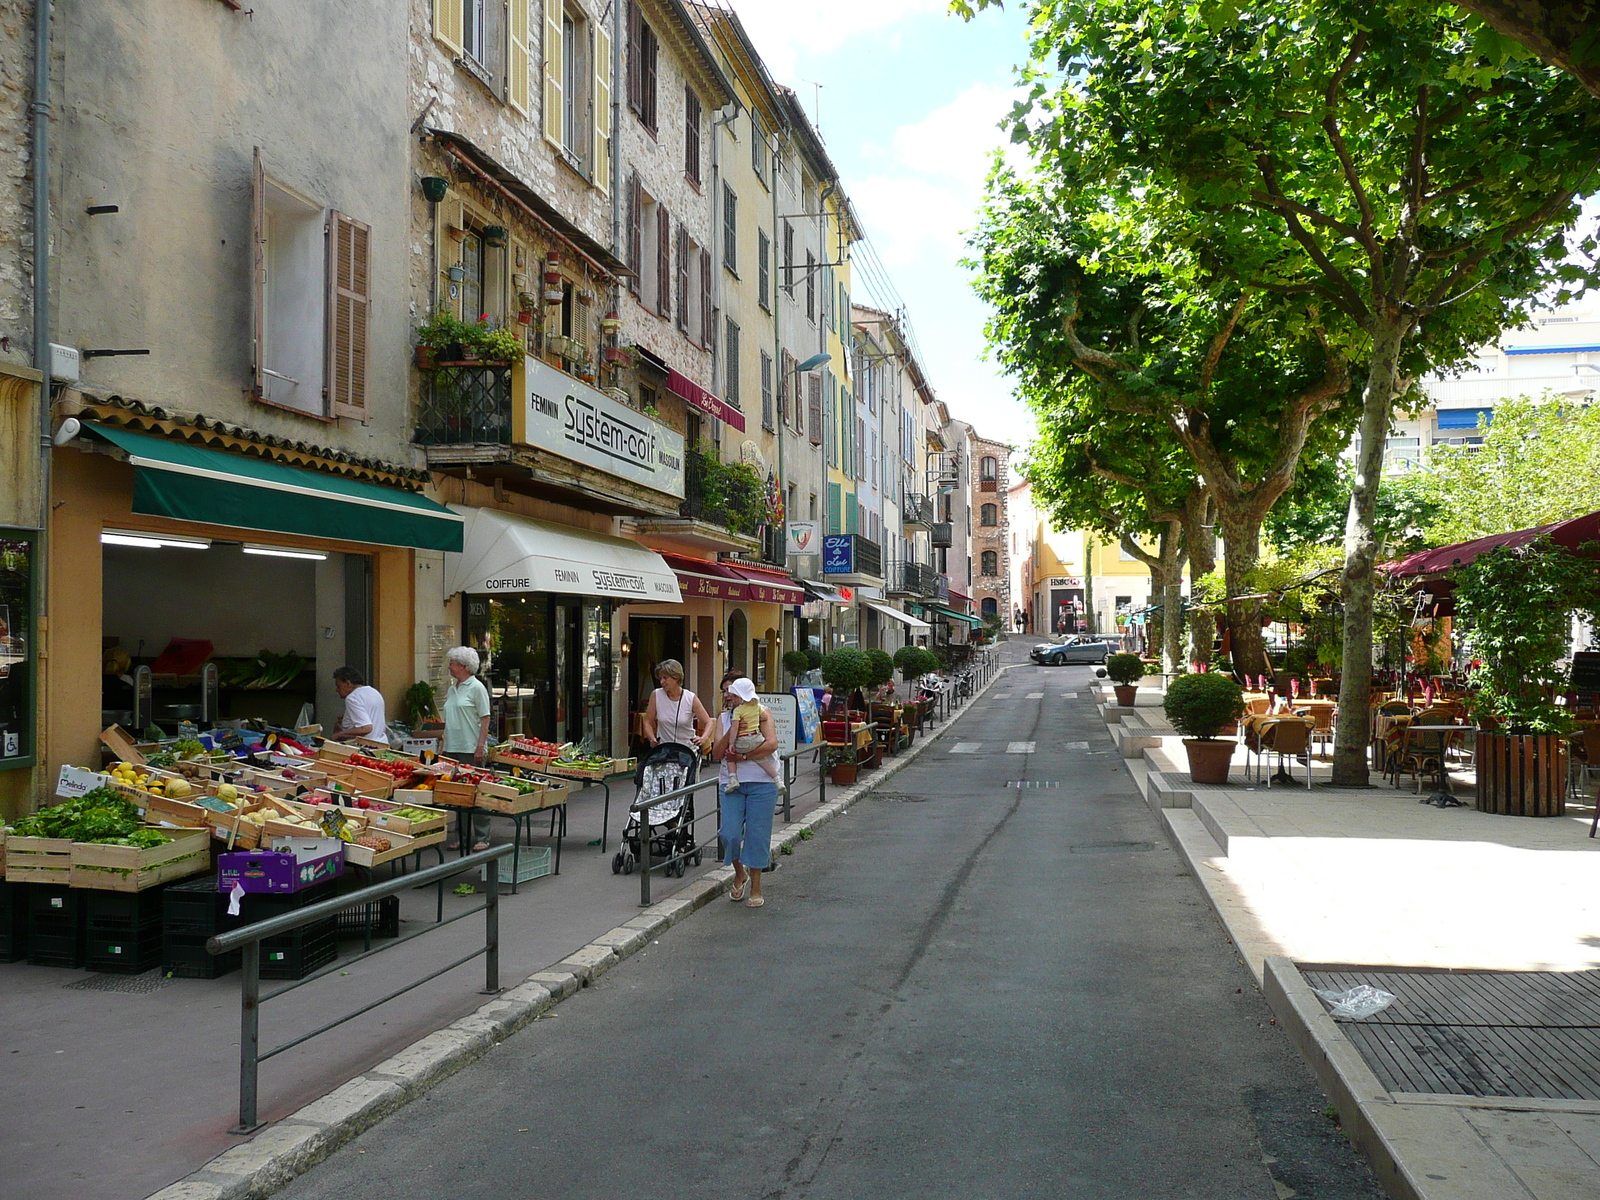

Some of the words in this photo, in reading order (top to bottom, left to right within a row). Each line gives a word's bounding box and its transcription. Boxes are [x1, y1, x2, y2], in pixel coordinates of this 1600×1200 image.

[531, 392, 559, 420] FEMININ
[658, 450, 680, 471] MASCULIN
[486, 578, 530, 589] COIFFURE
[554, 569, 580, 584] FEMININ
[654, 581, 674, 594] MASCULIN
[1050, 578, 1069, 586] HSBC
[60, 778, 87, 791] Melinda
